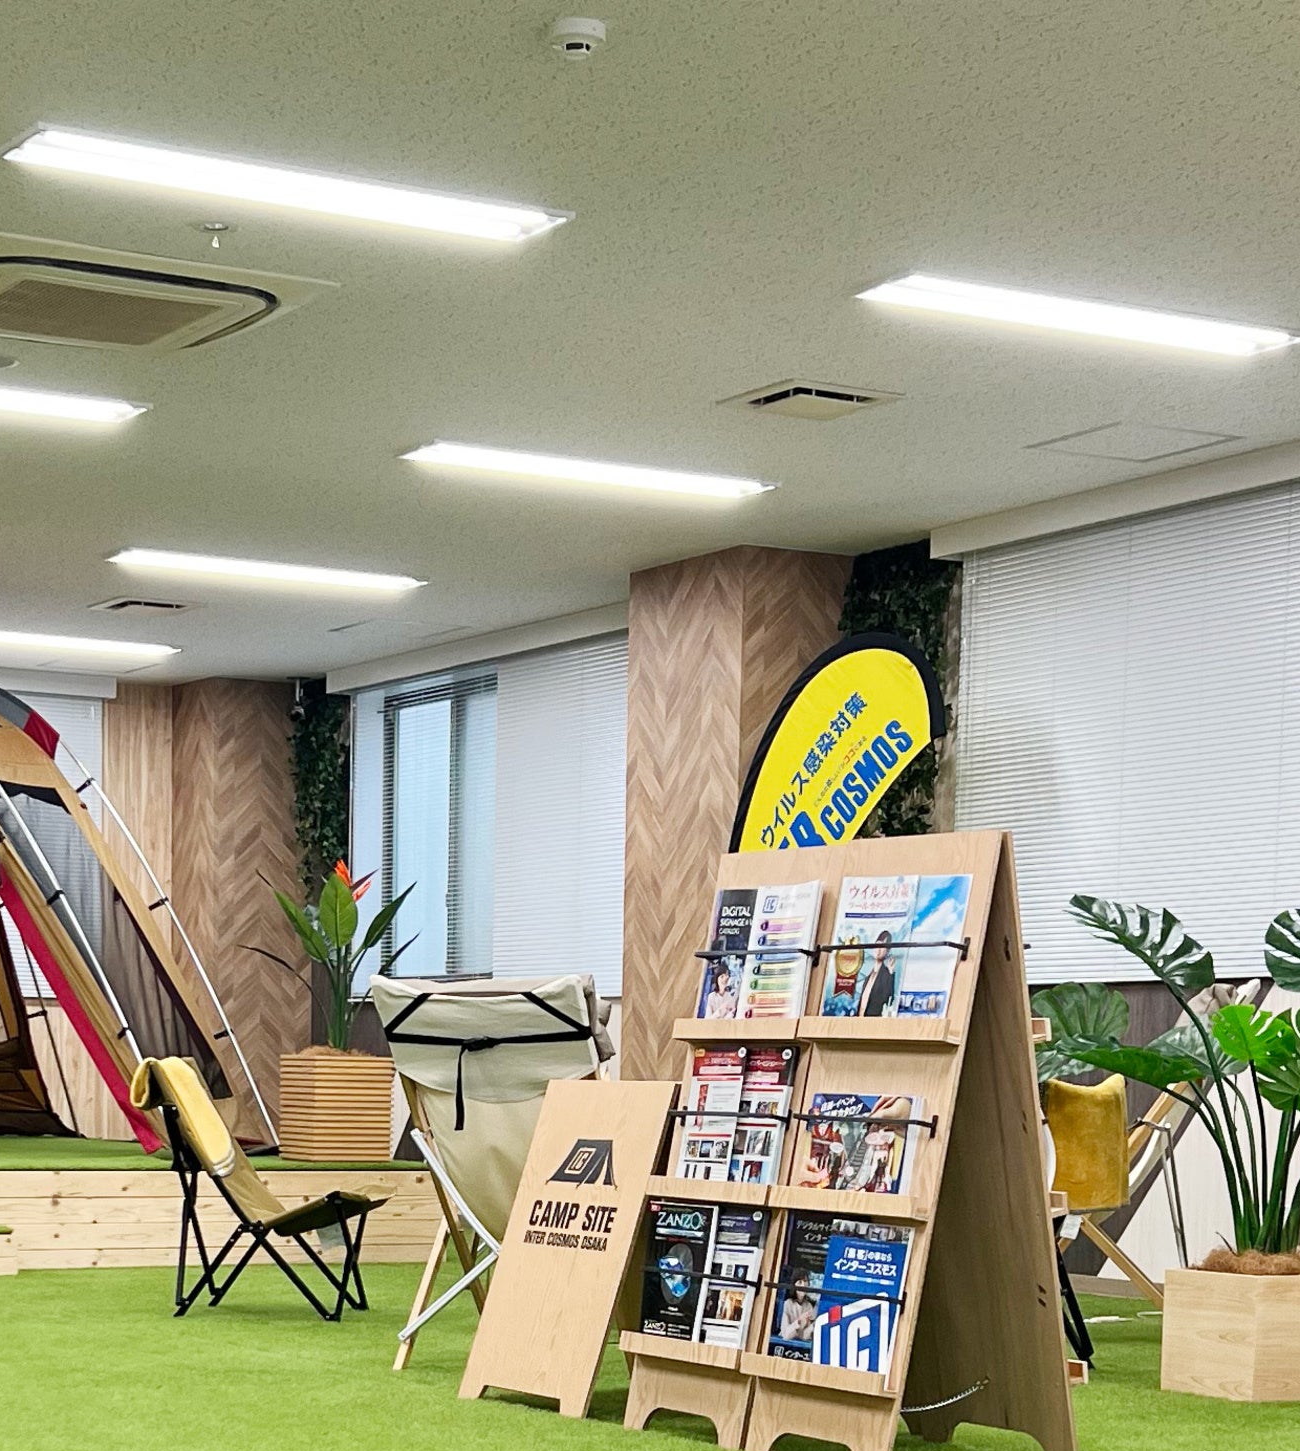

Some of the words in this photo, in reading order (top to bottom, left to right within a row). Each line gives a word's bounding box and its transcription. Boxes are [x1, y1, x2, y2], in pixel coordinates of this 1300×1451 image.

[760, 691, 868, 848] ウイルス感染対策
[820, 719, 914, 841] COSMOS
[721, 905, 752, 917] DIGITAL
[529, 1199, 580, 1229] CAMP
[582, 1205, 618, 1233] SITE
[656, 1211, 702, 1230] ZANZO
[523, 1230, 547, 1244] INTER
[546, 1232, 580, 1249] COSMOS
[581, 1235, 608, 1252] OSAKA
[833, 1258, 897, 1277] インターコスモス
